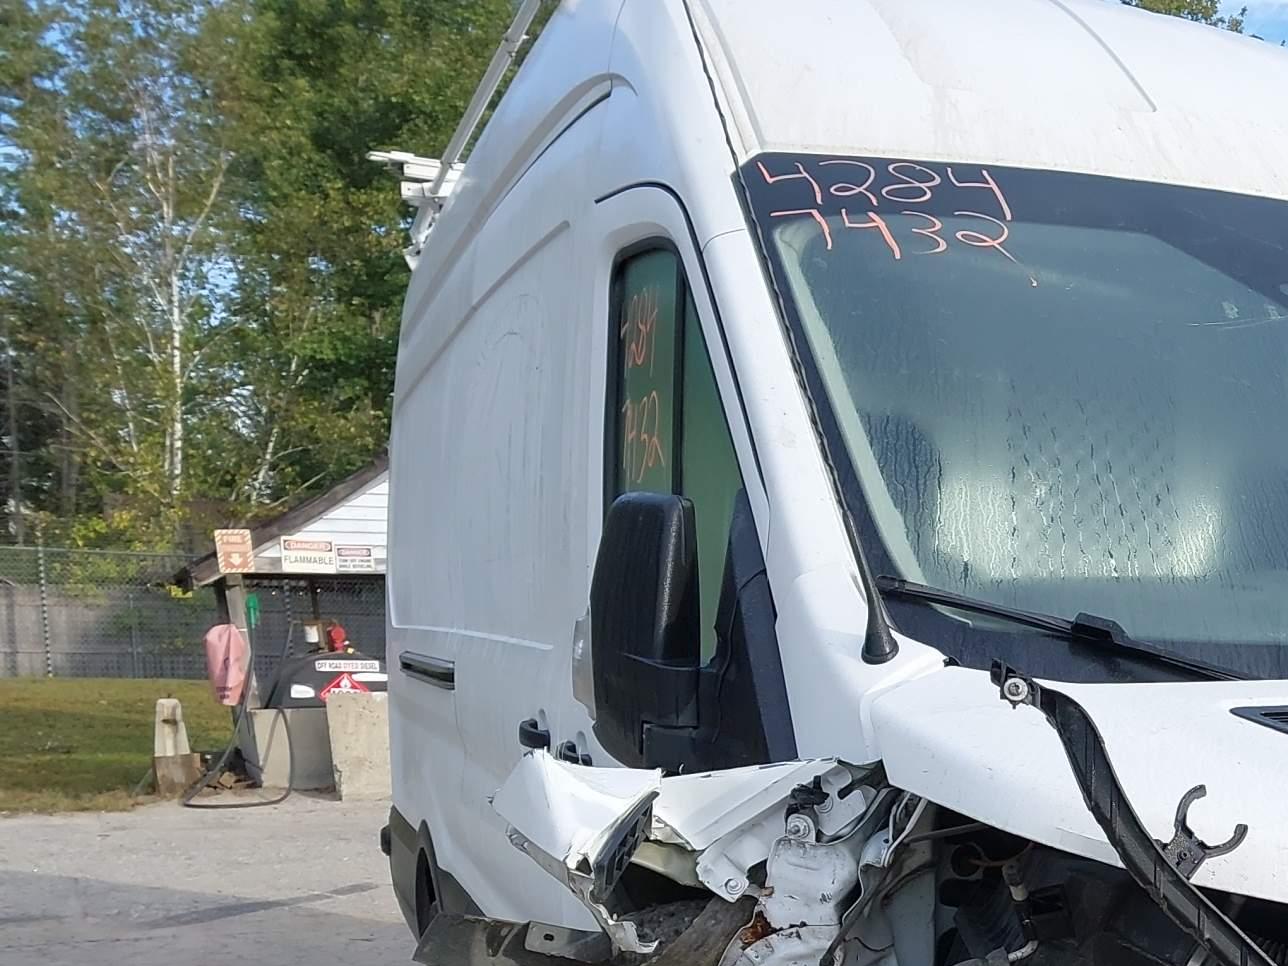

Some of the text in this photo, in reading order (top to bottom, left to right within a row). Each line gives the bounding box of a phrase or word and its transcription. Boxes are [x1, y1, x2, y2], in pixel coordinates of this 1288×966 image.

[757, 160, 1012, 222] 4284
[770, 207, 1017, 263] 7432
[567, 293, 658, 331] 42847432
[621, 390, 665, 484] 7432
[284, 555, 334, 566] FLAMMABLE
[290, 541, 330, 551] DANGER
